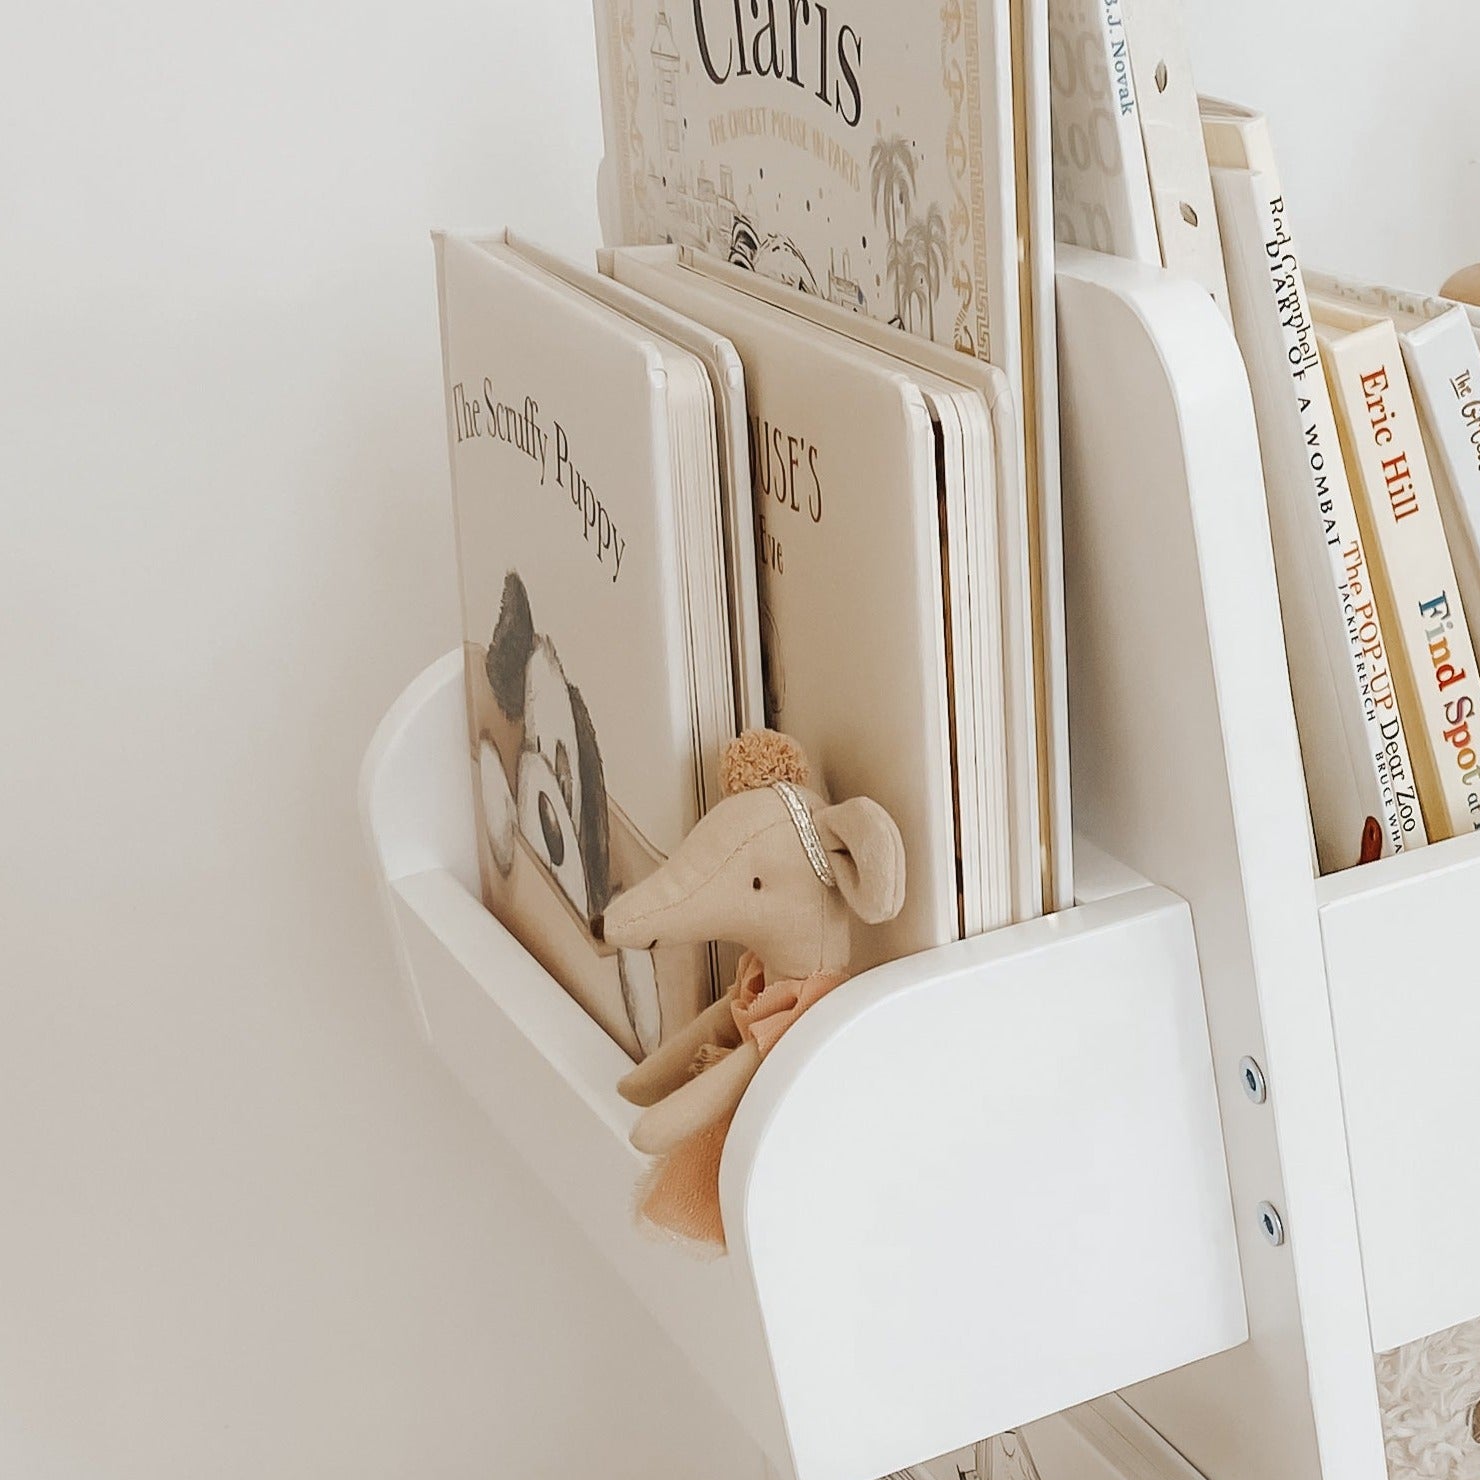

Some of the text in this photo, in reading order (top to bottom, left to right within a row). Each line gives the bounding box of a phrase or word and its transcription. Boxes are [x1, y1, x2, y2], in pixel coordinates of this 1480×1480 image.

[1111, 38, 1135, 116] Novak
[1265, 239, 1341, 546] DIARY OF A WOMBAT
[1360, 364, 1419, 524] Eric Hill
[453, 376, 626, 583] The Scruffy Puppy
[758, 513, 784, 575] Eve
[1338, 583, 1377, 721] JACKIE FRENCH
[1343, 540, 1416, 833] The POP-UP Dear Zoo
[1418, 589, 1466, 693] Find
[1374, 751, 1395, 807] BRUCE
